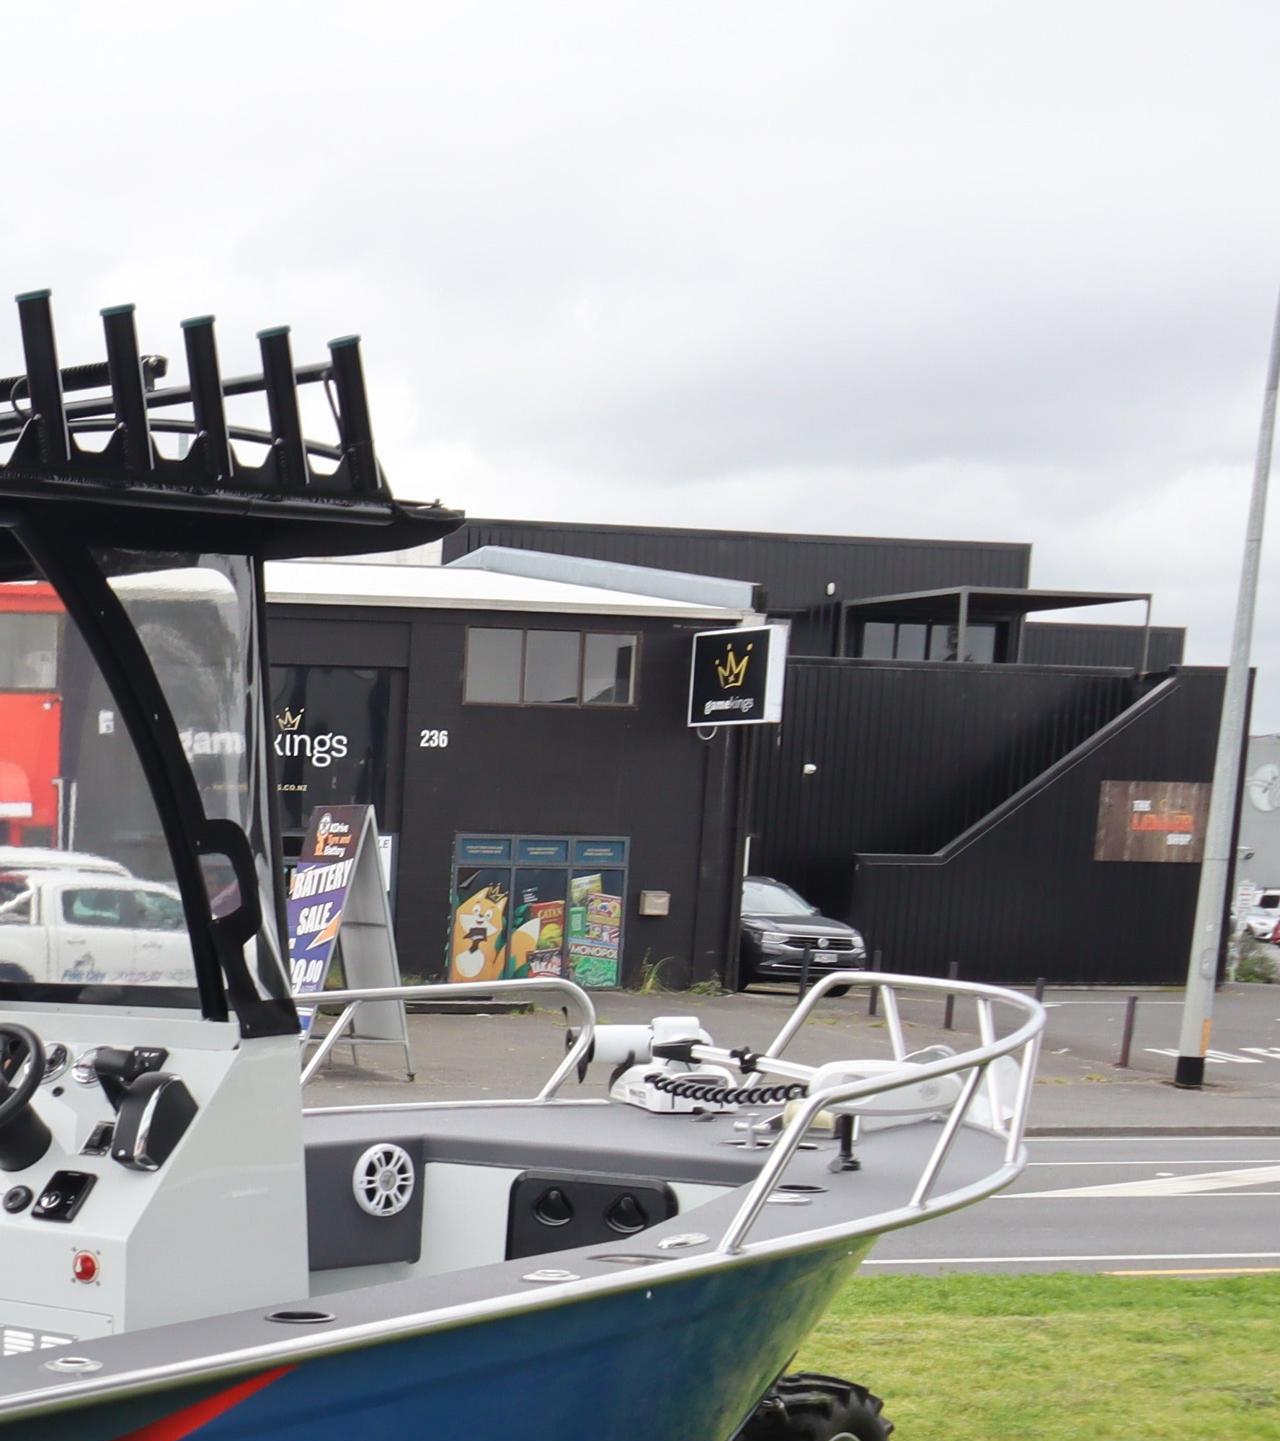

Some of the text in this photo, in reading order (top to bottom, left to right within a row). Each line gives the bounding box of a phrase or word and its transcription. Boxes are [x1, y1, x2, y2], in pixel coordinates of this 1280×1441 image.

[703, 695, 755, 715] gamekings
[420, 729, 449, 748] 236
[291, 857, 355, 901] BATTERY
[296, 901, 334, 937] SALE
